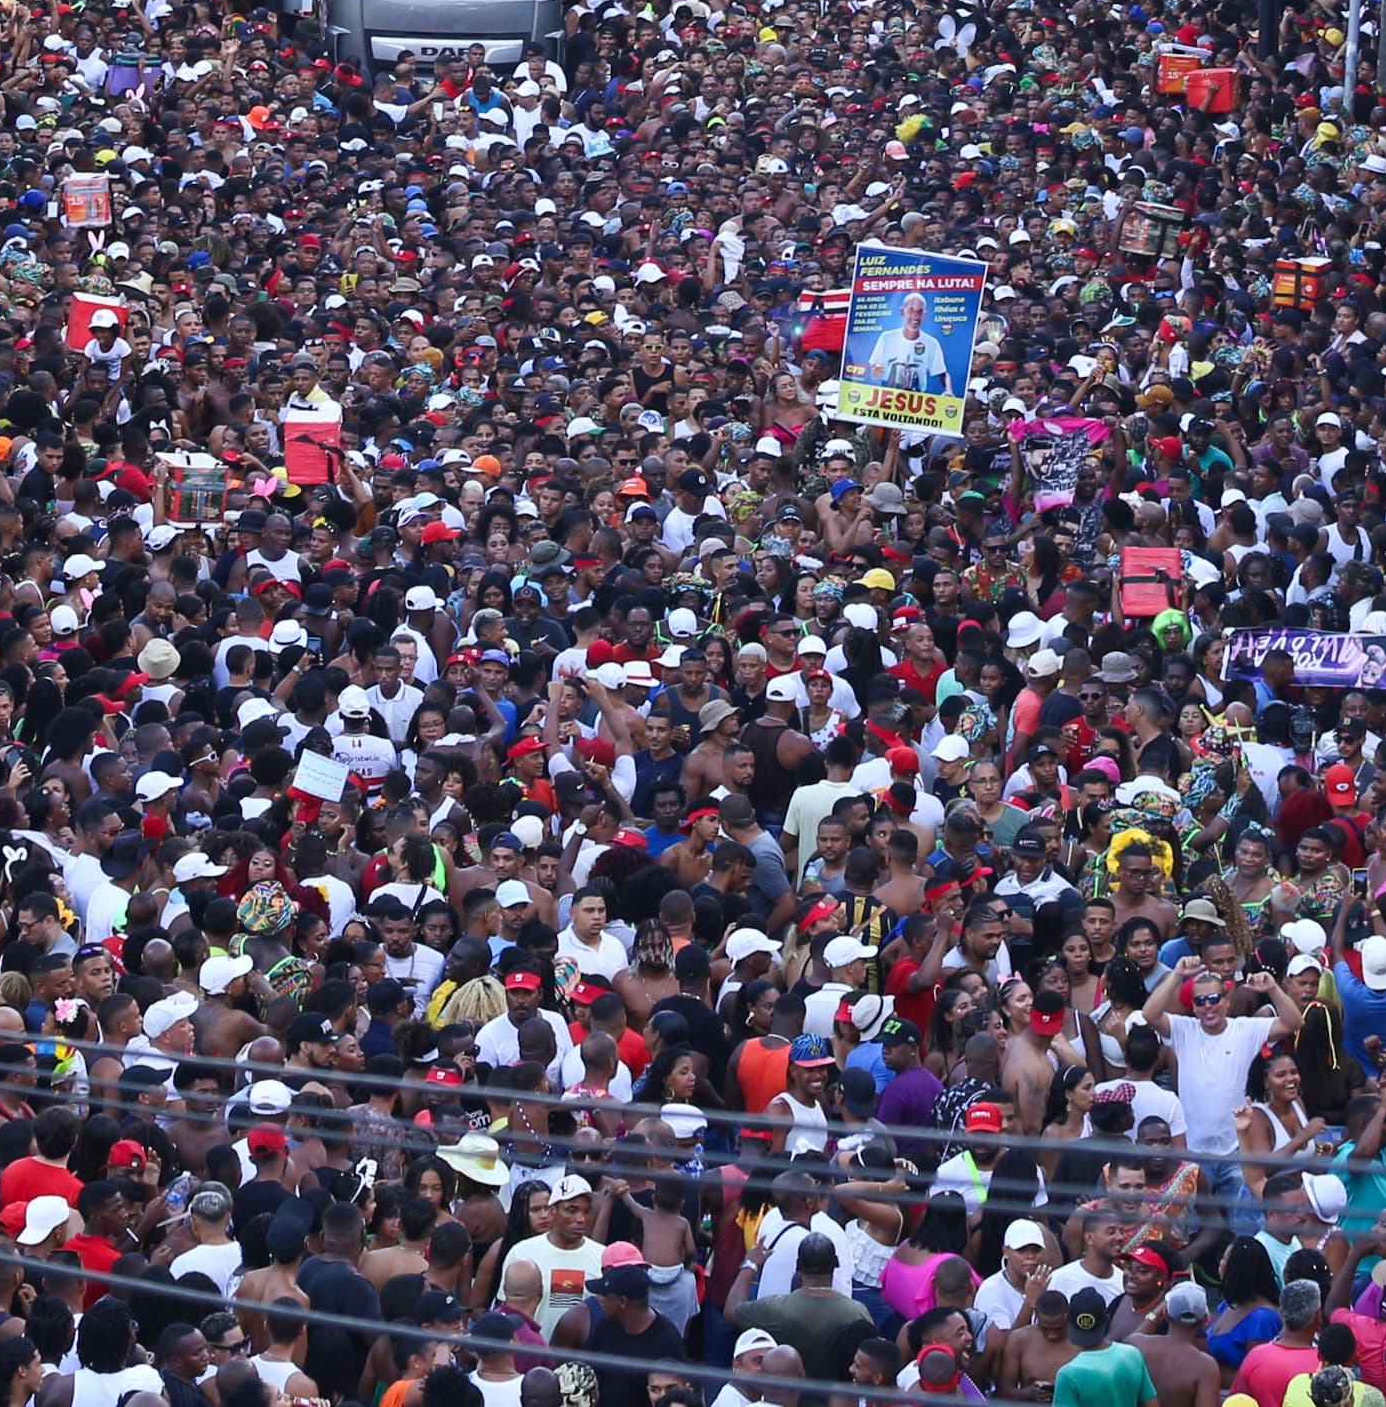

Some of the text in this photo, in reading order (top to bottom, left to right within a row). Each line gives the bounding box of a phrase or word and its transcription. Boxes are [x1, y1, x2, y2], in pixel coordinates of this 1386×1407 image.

[860, 256, 887, 266] LUIZ
[859, 265, 931, 277] FERNANDES
[863, 277, 975, 292] SEMPRE NA LUTA!
[933, 296, 966, 304] Itabuna
[934, 315, 968, 324] Uruçuca
[864, 388, 937, 416] JESUS
[853, 406, 943, 429] ESTÁ VOLTANDO!
[883, 1019, 902, 1034] 27
